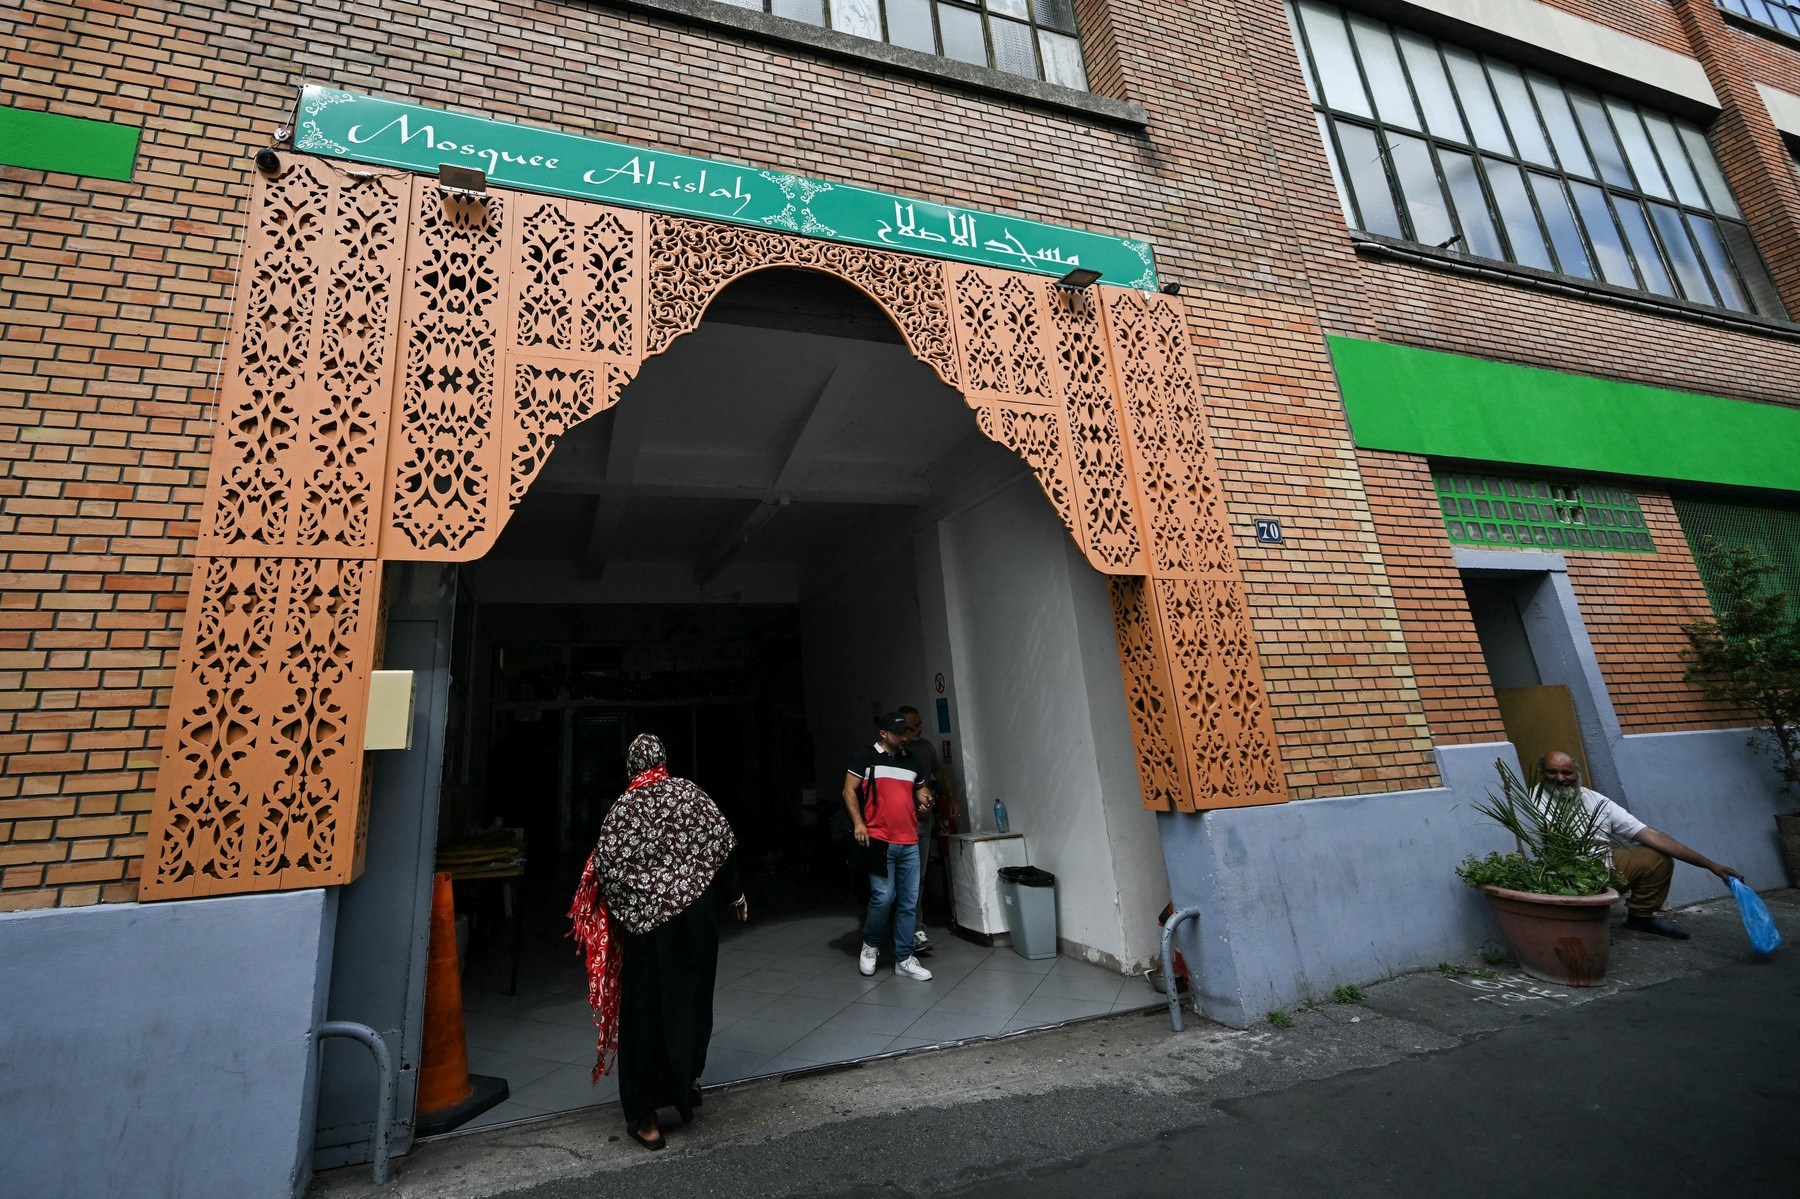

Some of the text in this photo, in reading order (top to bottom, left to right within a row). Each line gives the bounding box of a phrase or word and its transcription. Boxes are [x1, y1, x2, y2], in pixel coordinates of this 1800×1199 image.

[347, 113, 752, 216] Mosquee Al-islah
[984, 227, 1080, 267] مسجد
[1258, 522, 1279, 539] 70
